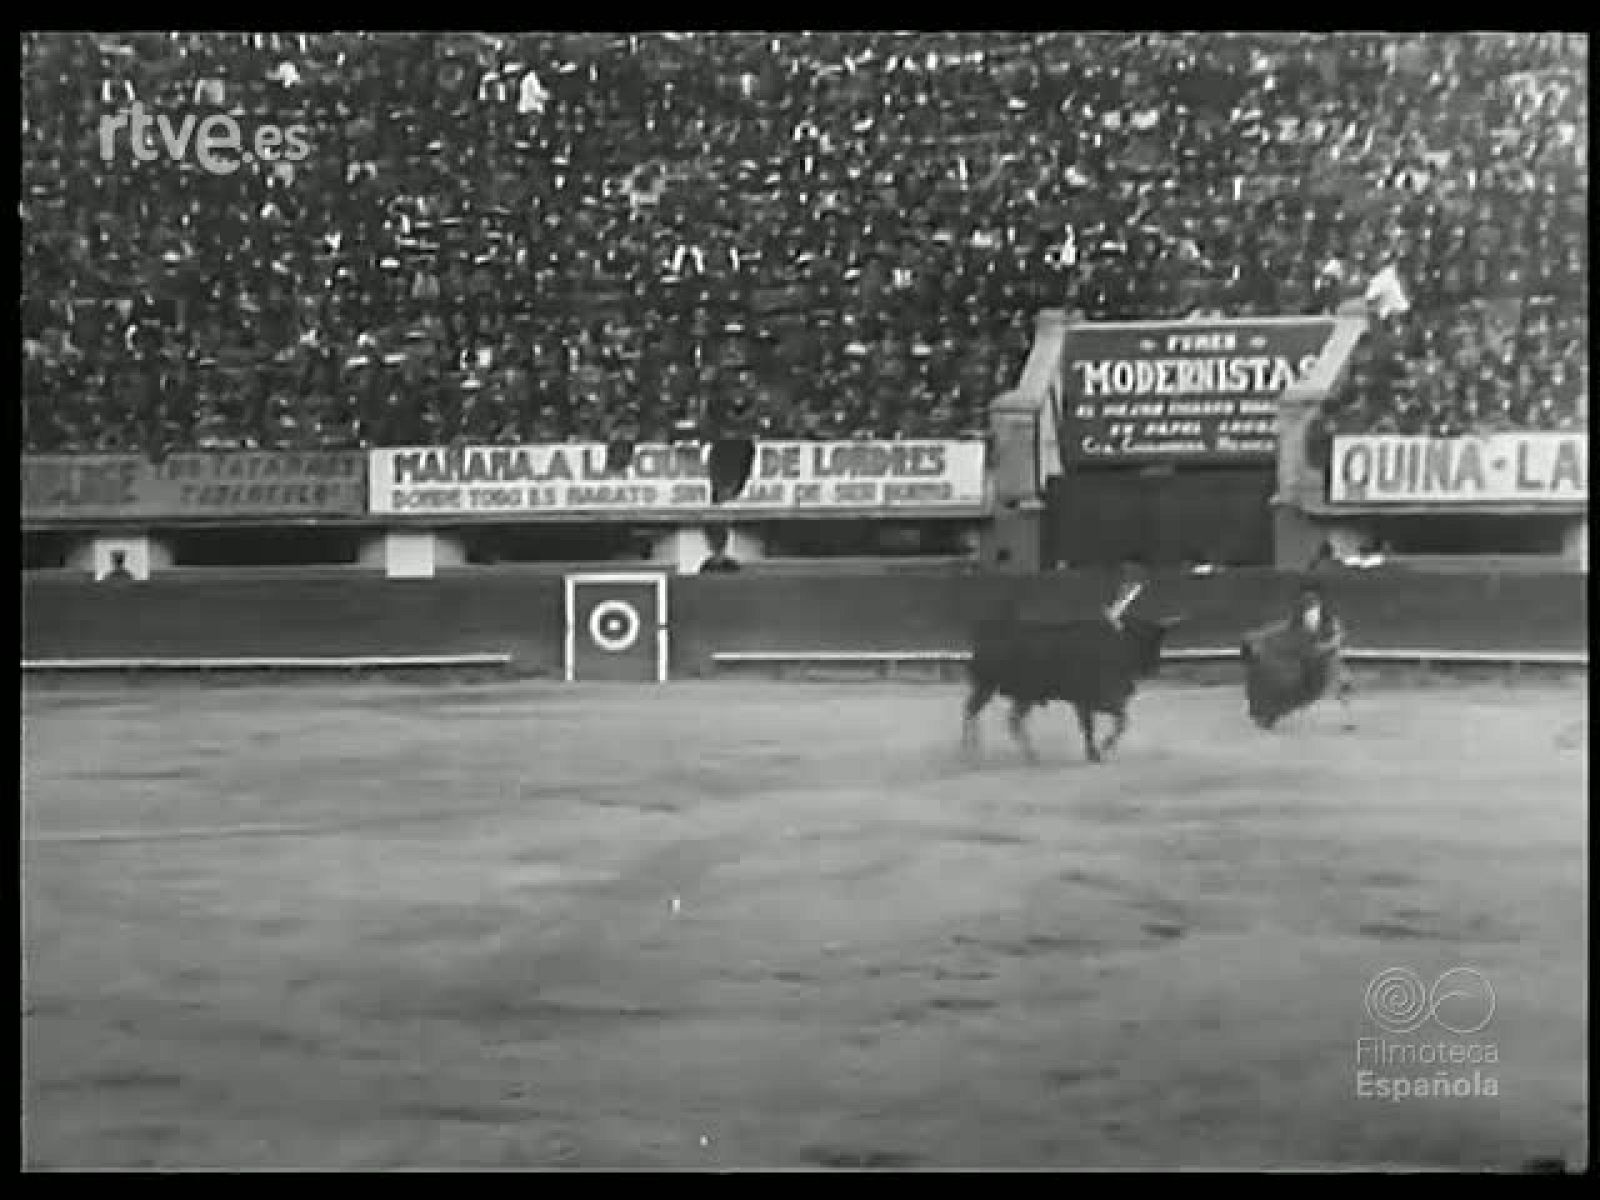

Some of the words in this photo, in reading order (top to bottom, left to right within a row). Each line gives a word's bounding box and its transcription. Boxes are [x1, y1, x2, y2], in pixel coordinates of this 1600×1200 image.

[1073, 355, 1319, 396] MODERNISTAS
[761, 446, 801, 478] DE
[814, 445, 946, 478] LONDRES
[1341, 441, 1485, 500] QUINA
